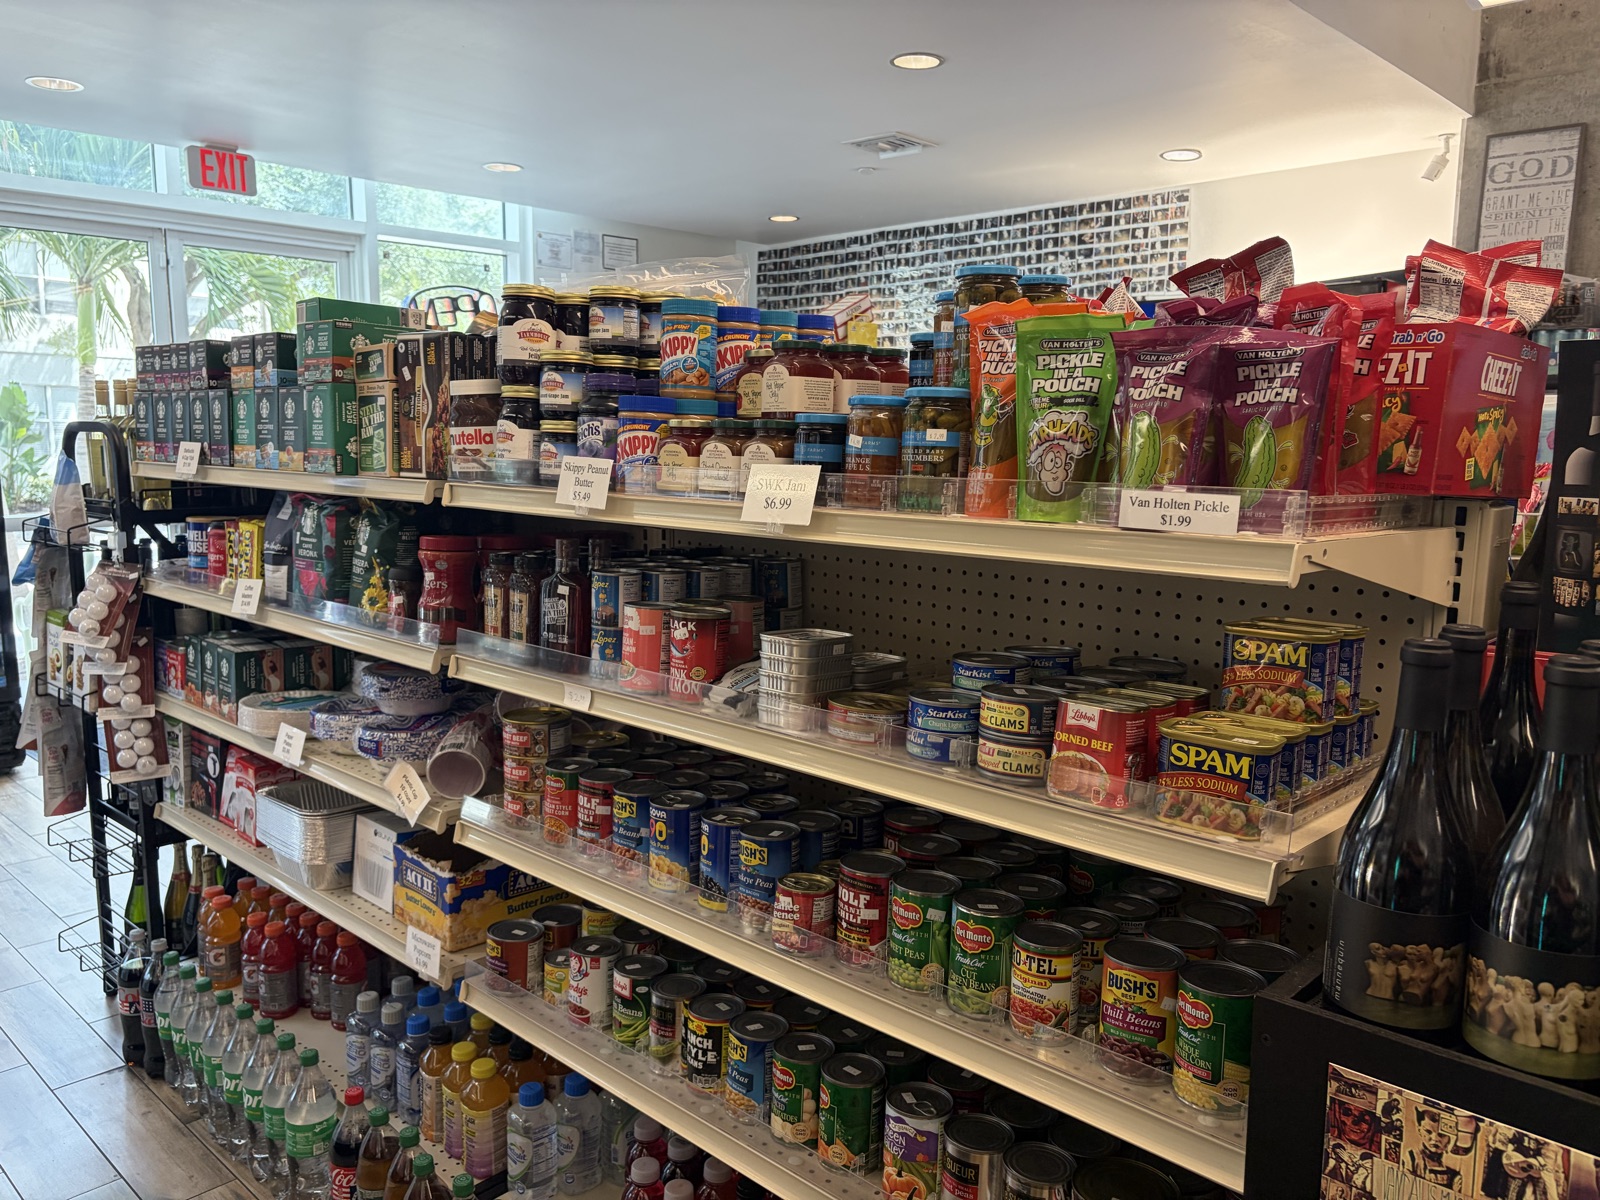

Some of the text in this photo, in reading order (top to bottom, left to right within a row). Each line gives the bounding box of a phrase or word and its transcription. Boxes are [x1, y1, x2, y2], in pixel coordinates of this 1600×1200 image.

[200, 148, 249, 193] EXIT
[1488, 155, 1574, 184] GOD
[1484, 206, 1570, 221] SERENITY
[1062, 340, 1100, 348] HOLTEN'S
[1427, 330, 1444, 344] Go
[660, 335, 697, 361] KIPPY
[1237, 348, 1301, 360] VAN HOLTEN'S
[1036, 352, 1104, 370] PICKLE
[1139, 353, 1157, 361] VAN
[335, 369, 343, 377] 10
[1053, 368, 1083, 379] IN-A
[1129, 361, 1188, 379] PICKLE
[1236, 362, 1302, 382] PICKLE
[1032, 378, 1102, 394] POUCH
[1254, 378, 1281, 390] IN-A
[1127, 384, 1184, 401] POUCH
[1234, 388, 1299, 407] POUCH
[370, 411, 385, 425] THE
[361, 425, 374, 440] RAW
[450, 428, 494, 446] nutella
[901, 454, 944, 462] CUCUMBERS
[564, 462, 609, 475] Skippy Peanut
[574, 477, 595, 488] Butter
[757, 478, 806, 493] SWK Jam
[572, 491, 591, 502] $5.49
[763, 496, 792, 511] $6.99
[1129, 497, 1230, 513] Van Holten Pickle
[1160, 514, 1192, 528] $1.99
[670, 619, 697, 631] LACK
[596, 631, 617, 646] Lopez
[1232, 638, 1309, 668] SPAM
[957, 666, 992, 679] StarKist
[1235, 669, 1257, 681] LESS
[1257, 670, 1298, 684] SODIUM
[927, 708, 968, 720] StarKist
[1069, 709, 1096, 723] Libby's
[989, 715, 1025, 730] CLAMS
[513, 734, 528, 742] BEEF
[1091, 740, 1114, 752] BEEF
[1169, 743, 1253, 779] SPAM
[1002, 762, 1041, 775] CLAMS
[1172, 777, 1195, 788] LESS
[1195, 778, 1239, 795] SODIUM
[618, 828, 640, 839] Beans
[406, 868, 422, 889] ACT
[459, 875, 473, 887] 32
[755, 878, 774, 889] Peas
[507, 891, 570, 915] Butter Lovers
[899, 907, 920, 921] Monte
[956, 925, 992, 944] Del Monte
[904, 948, 925, 960] PEAS
[955, 952, 971, 966] Fresh
[960, 966, 978, 980] CUT
[1334, 940, 1345, 1001] mannequin
[969, 977, 996, 992] BEANS
[1108, 970, 1157, 1001] BUSH'S
[1020, 987, 1047, 1000] TOMATOES
[1121, 993, 1136, 1001] BEST
[618, 1004, 644, 1018] Beans
[1103, 1004, 1162, 1029] Chili Beans
[1185, 1004, 1210, 1021] Monte
[1107, 1018, 1127, 1028] KIDNEY
[688, 1044, 718, 1062] TYLE
[1178, 1037, 1200, 1058] WHOLE
[1190, 1054, 1212, 1070] CORN
[731, 1071, 749, 1084] Peas
[955, 1187, 974, 1199] peas
